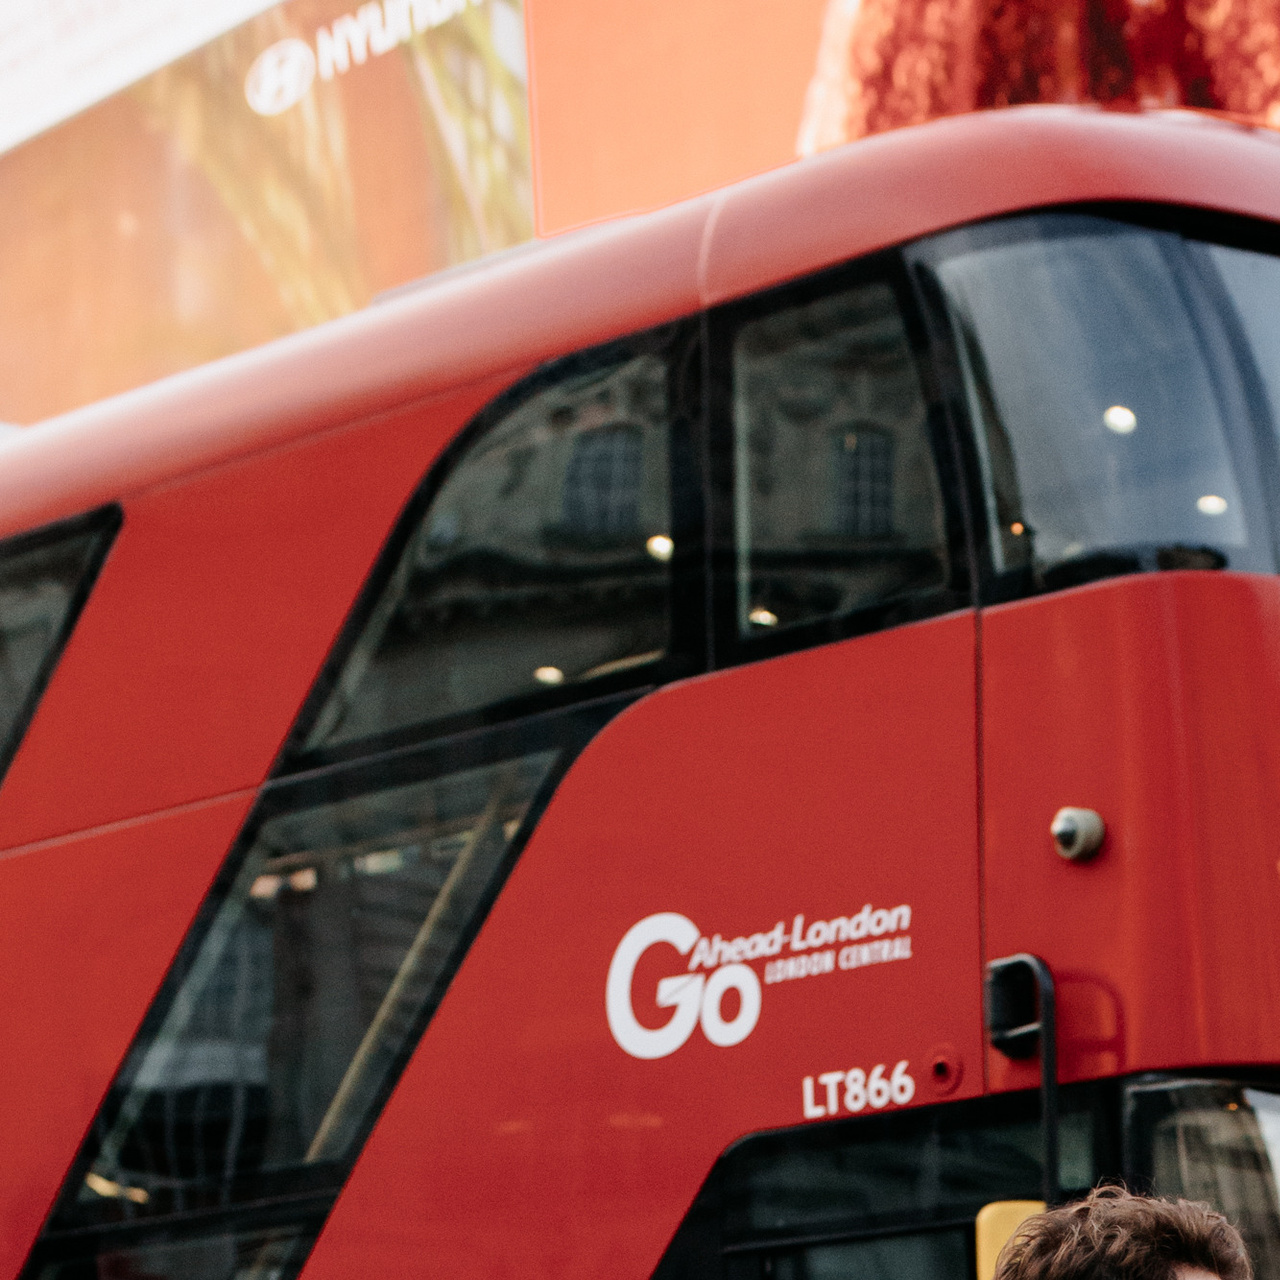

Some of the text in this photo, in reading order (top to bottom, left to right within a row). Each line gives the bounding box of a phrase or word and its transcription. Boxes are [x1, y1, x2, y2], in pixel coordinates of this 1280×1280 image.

[315, 0, 482, 82] HYUN
[688, 903, 912, 971] Ahead-London
[605, 911, 762, 1060] Go
[803, 1060, 916, 1119] LT866
